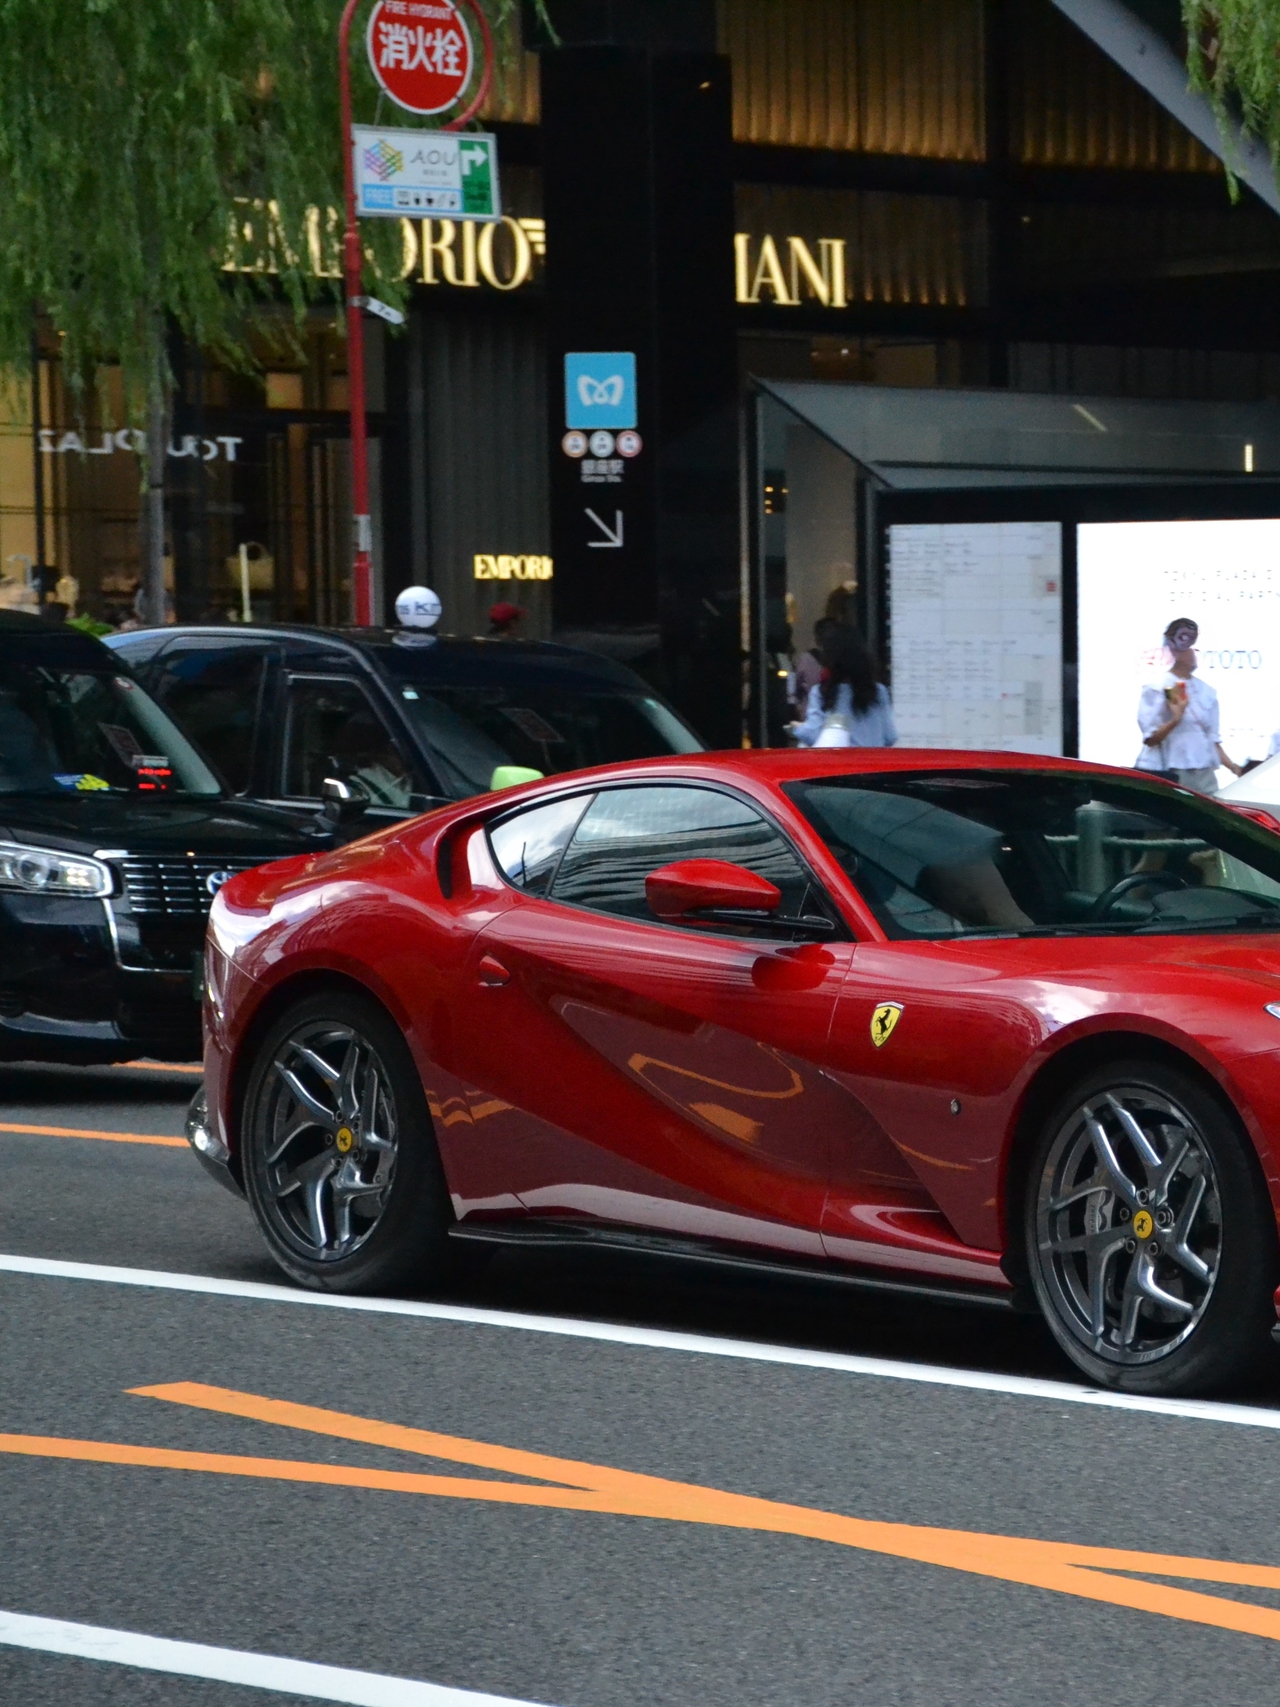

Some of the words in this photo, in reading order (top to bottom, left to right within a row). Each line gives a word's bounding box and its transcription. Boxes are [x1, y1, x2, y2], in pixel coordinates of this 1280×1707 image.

[386, 0, 407, 15] FIRE
[409, 3, 452, 20] HYDRANT
[378, 21, 463, 76] 消火栓
